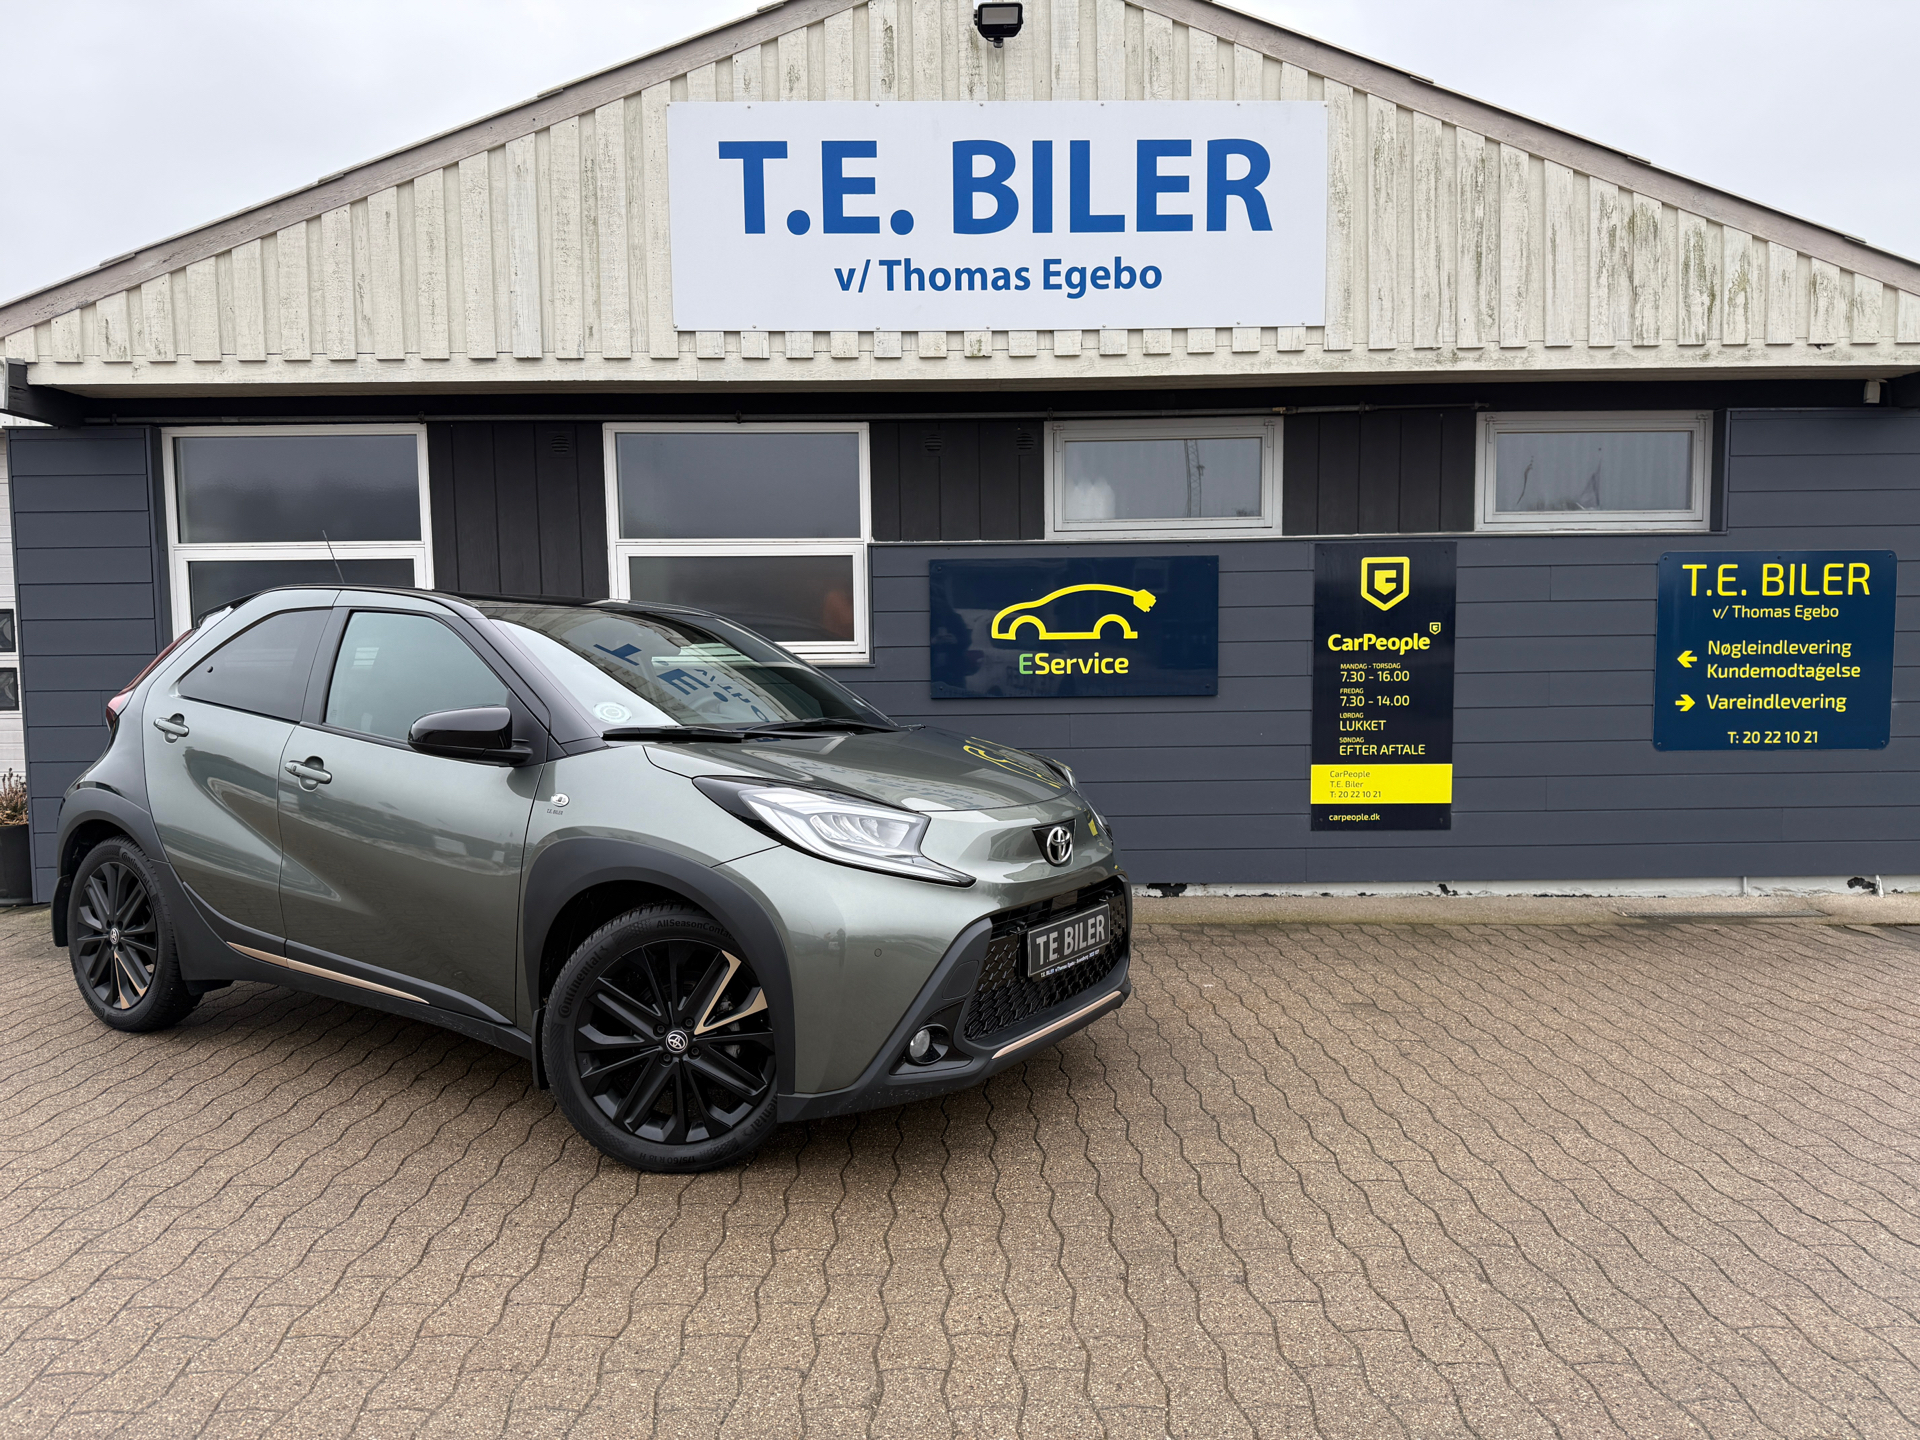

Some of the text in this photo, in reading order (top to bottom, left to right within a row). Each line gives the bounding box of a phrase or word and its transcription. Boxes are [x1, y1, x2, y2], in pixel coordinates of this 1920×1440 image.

[719, 139, 1272, 235] T.E. BILER
[835, 257, 1162, 299] v/ Thomas Egebo
[1683, 563, 1870, 596] T.E. BILER
[1712, 605, 1840, 621] v/ Thomas Egebo
[1327, 632, 1431, 656] CarPeople
[1708, 640, 1852, 658] Nøgleindlevering
[1019, 652, 1129, 675] EService
[1372, 662, 1401, 670] TORSDAG
[1340, 671, 1366, 682] 7.30
[1377, 671, 1410, 681] 16.00
[1707, 663, 1861, 681] Kundemodtagelse
[1339, 687, 1364, 695] FREDAG
[1339, 696, 1365, 706] 7.30
[1376, 695, 1410, 706] 14.00
[1706, 694, 1847, 712] Vareindlevering
[1339, 720, 1387, 731] LUKKET
[1339, 736, 1365, 744] SØNDAG
[1727, 731, 1818, 744] T: 20 22 10 21
[1339, 744, 1426, 755] EFTER AFTALE
[1329, 770, 1371, 779] CarPeople
[1344, 780, 1364, 788] Biler
[1338, 790, 1349, 799] 20
[1350, 790, 1361, 799] 22
[1362, 790, 1372, 798] 10
[1372, 790, 1382, 798] 21
[1328, 813, 1381, 822] carpeople.dk
[656, 919, 734, 942] AllSeasonContac
[1064, 914, 1105, 956] BILER
[558, 951, 604, 1018] Continental
[660, 1156, 666, 1164] R
[667, 1155, 696, 1165] 175/60
